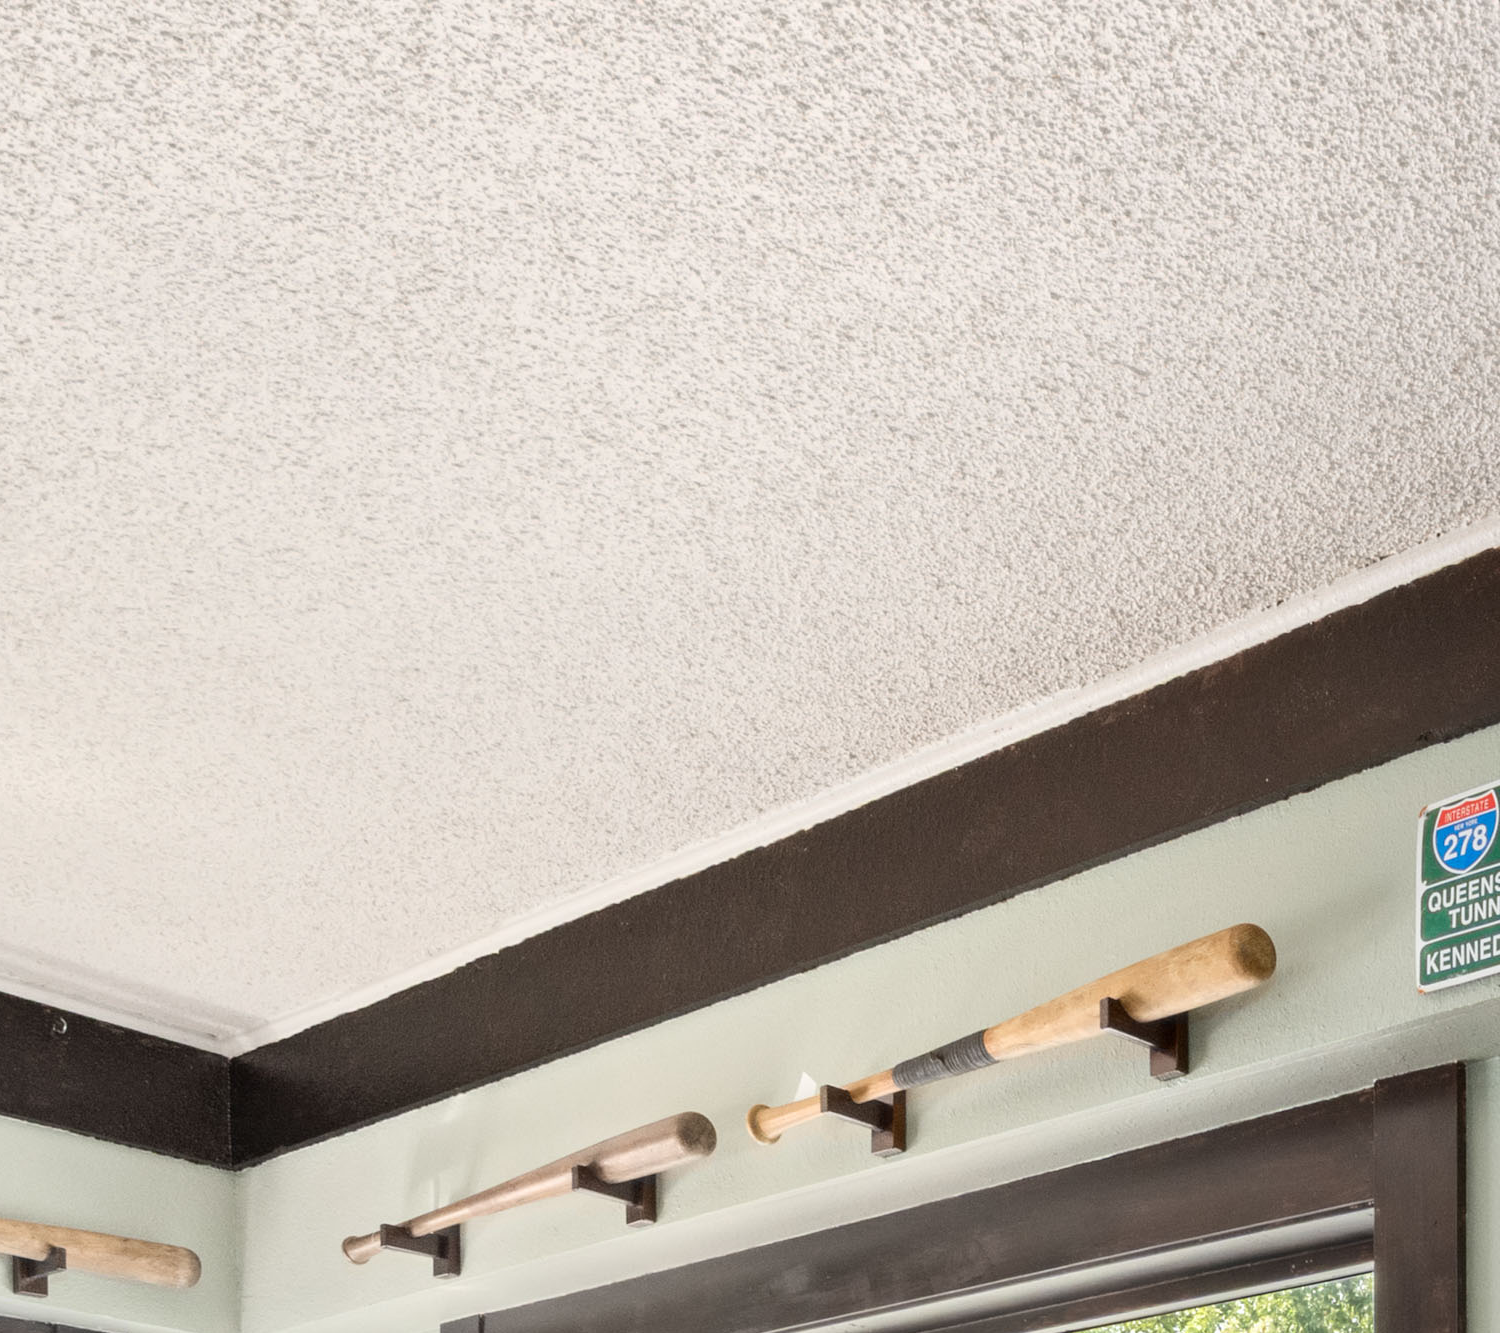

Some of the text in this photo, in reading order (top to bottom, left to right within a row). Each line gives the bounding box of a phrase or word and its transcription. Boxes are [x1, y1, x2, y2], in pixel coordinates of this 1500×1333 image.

[1444, 798, 1490, 823] INTERSTATE
[1454, 818, 1478, 831] NEW YORK
[1443, 824, 1487, 861] 278
